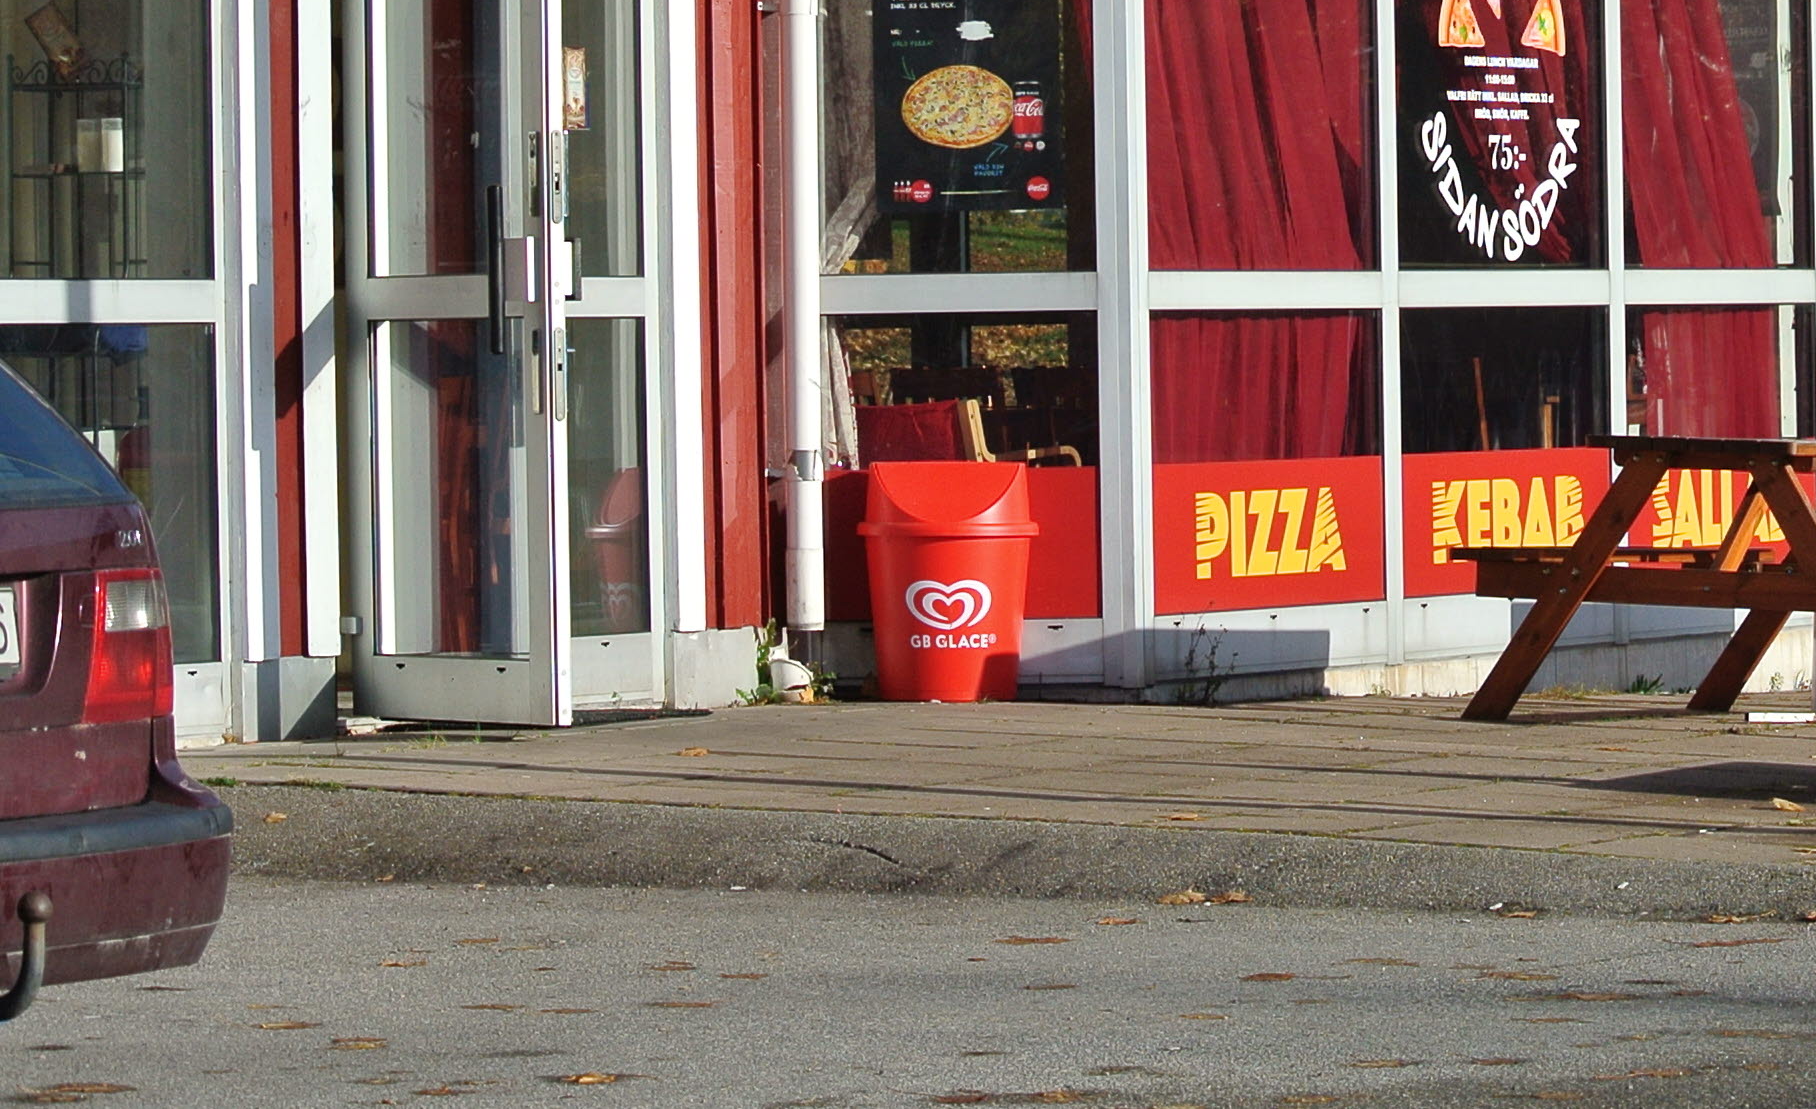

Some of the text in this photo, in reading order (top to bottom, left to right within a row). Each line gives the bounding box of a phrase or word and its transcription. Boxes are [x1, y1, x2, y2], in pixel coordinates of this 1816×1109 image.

[1422, 111, 1580, 261] SIDAN SÖDRA
[1196, 486, 1346, 580] PIZZA
[1432, 475, 1585, 564] KEBAB
[910, 635, 931, 648] GB
